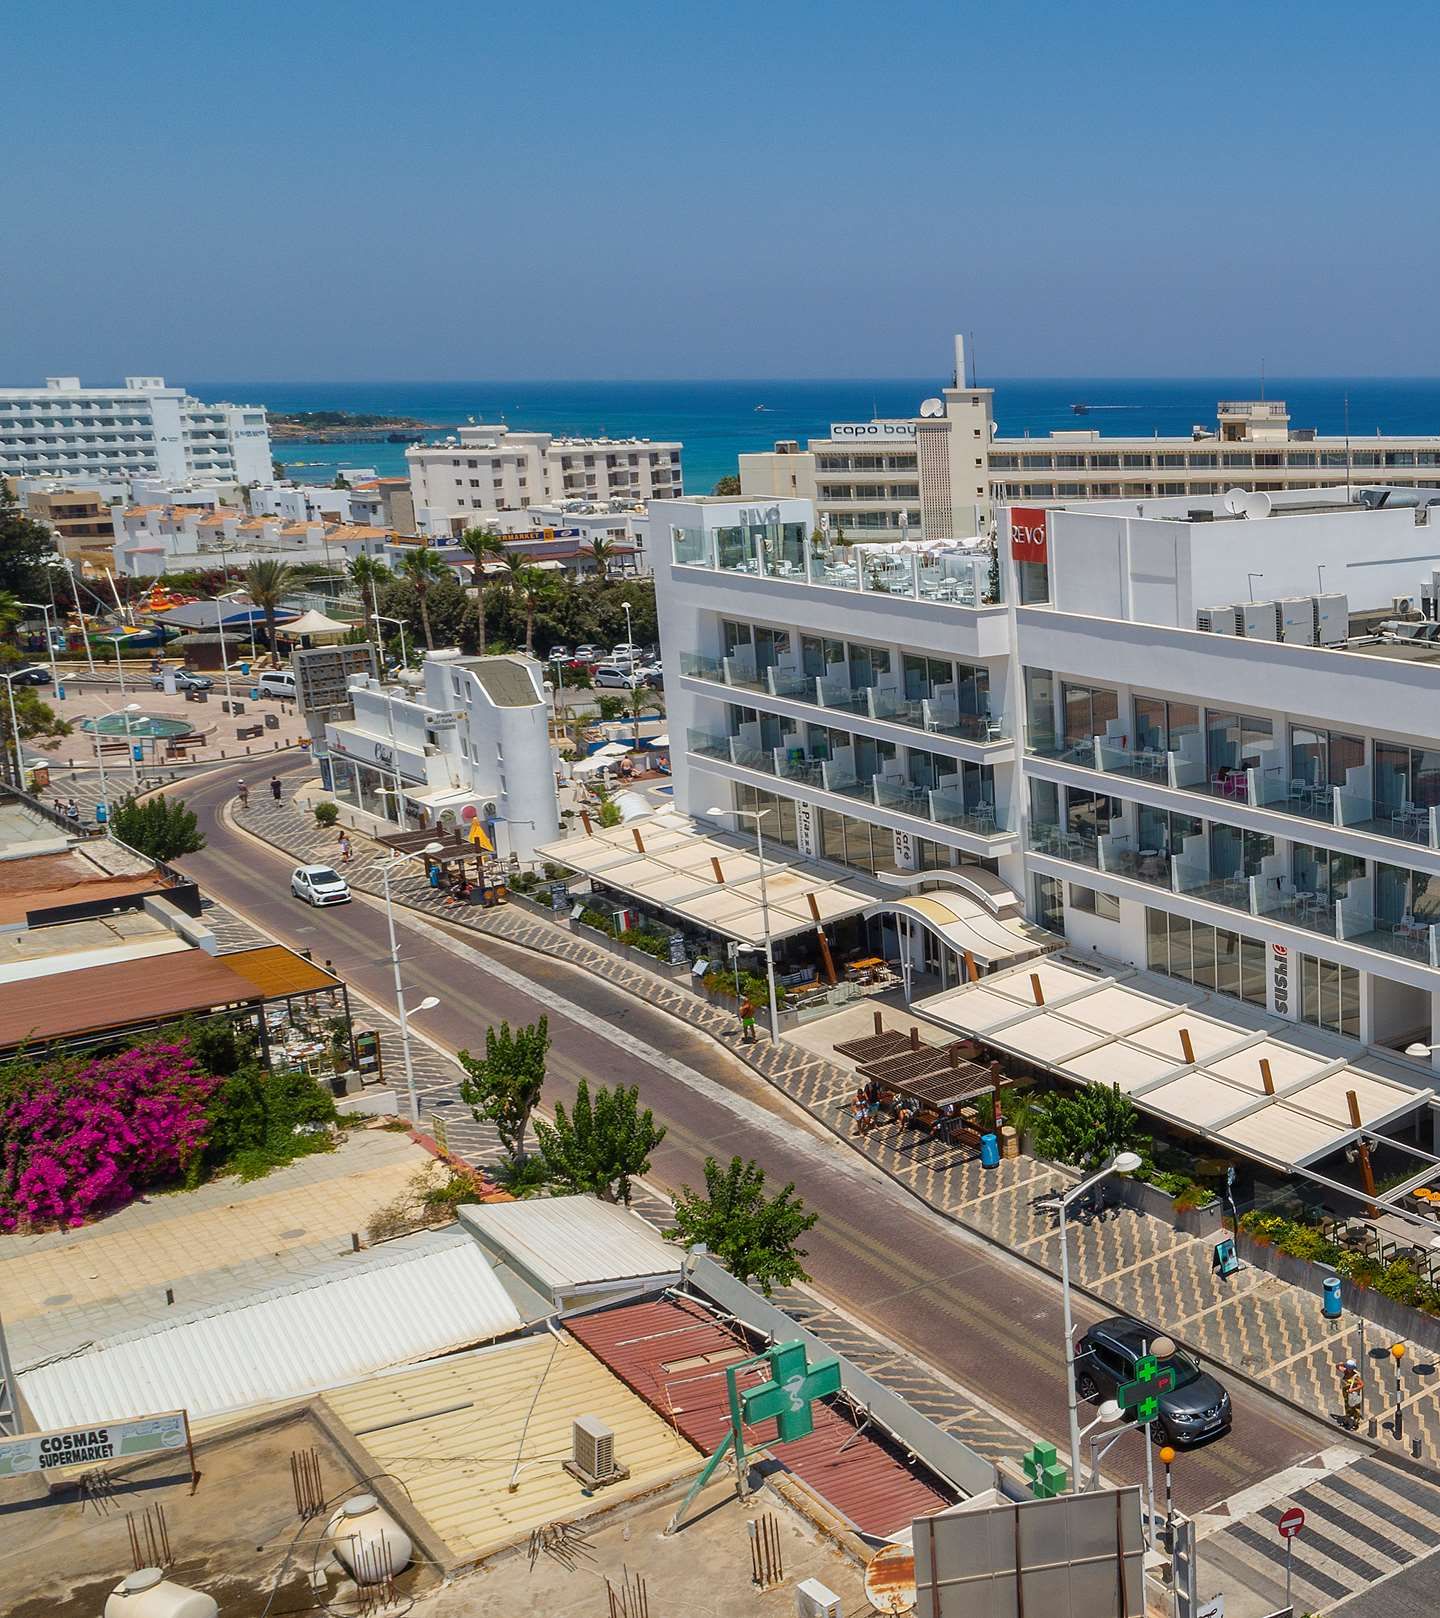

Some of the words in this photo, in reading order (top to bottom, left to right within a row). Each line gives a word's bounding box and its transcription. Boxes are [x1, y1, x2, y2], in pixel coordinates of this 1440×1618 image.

[833, 425, 878, 436] capo
[883, 424, 917, 437] bay
[902, 831, 911, 860] afé
[40, 1429, 109, 1453] COSMAS
[39, 1443, 114, 1469] SUPERMARKET
